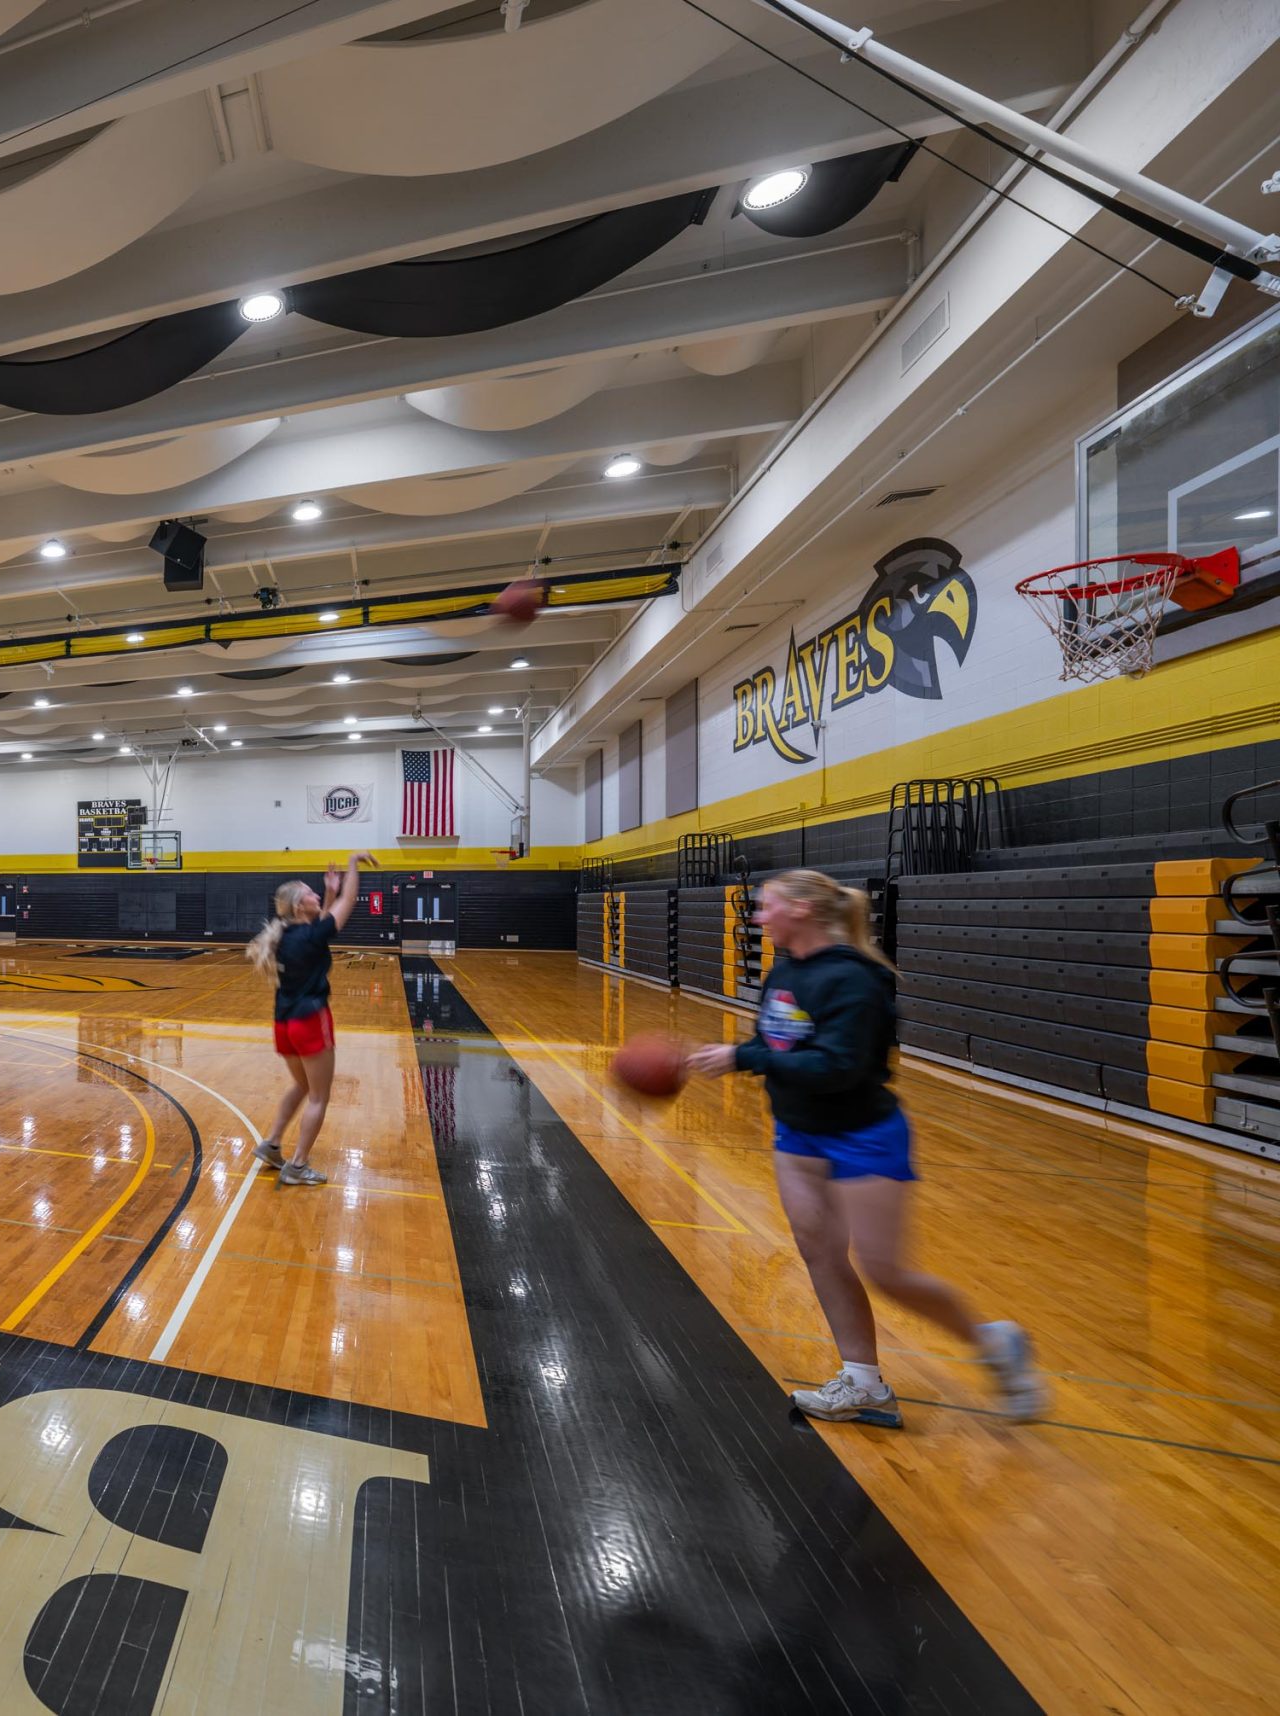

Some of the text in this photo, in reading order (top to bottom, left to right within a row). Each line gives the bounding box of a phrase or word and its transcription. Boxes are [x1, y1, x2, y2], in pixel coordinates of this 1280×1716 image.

[733, 597, 894, 764] BRAVES
[80, 808, 127, 816] BASKETBA
[323, 796, 360, 815] NJCAA
